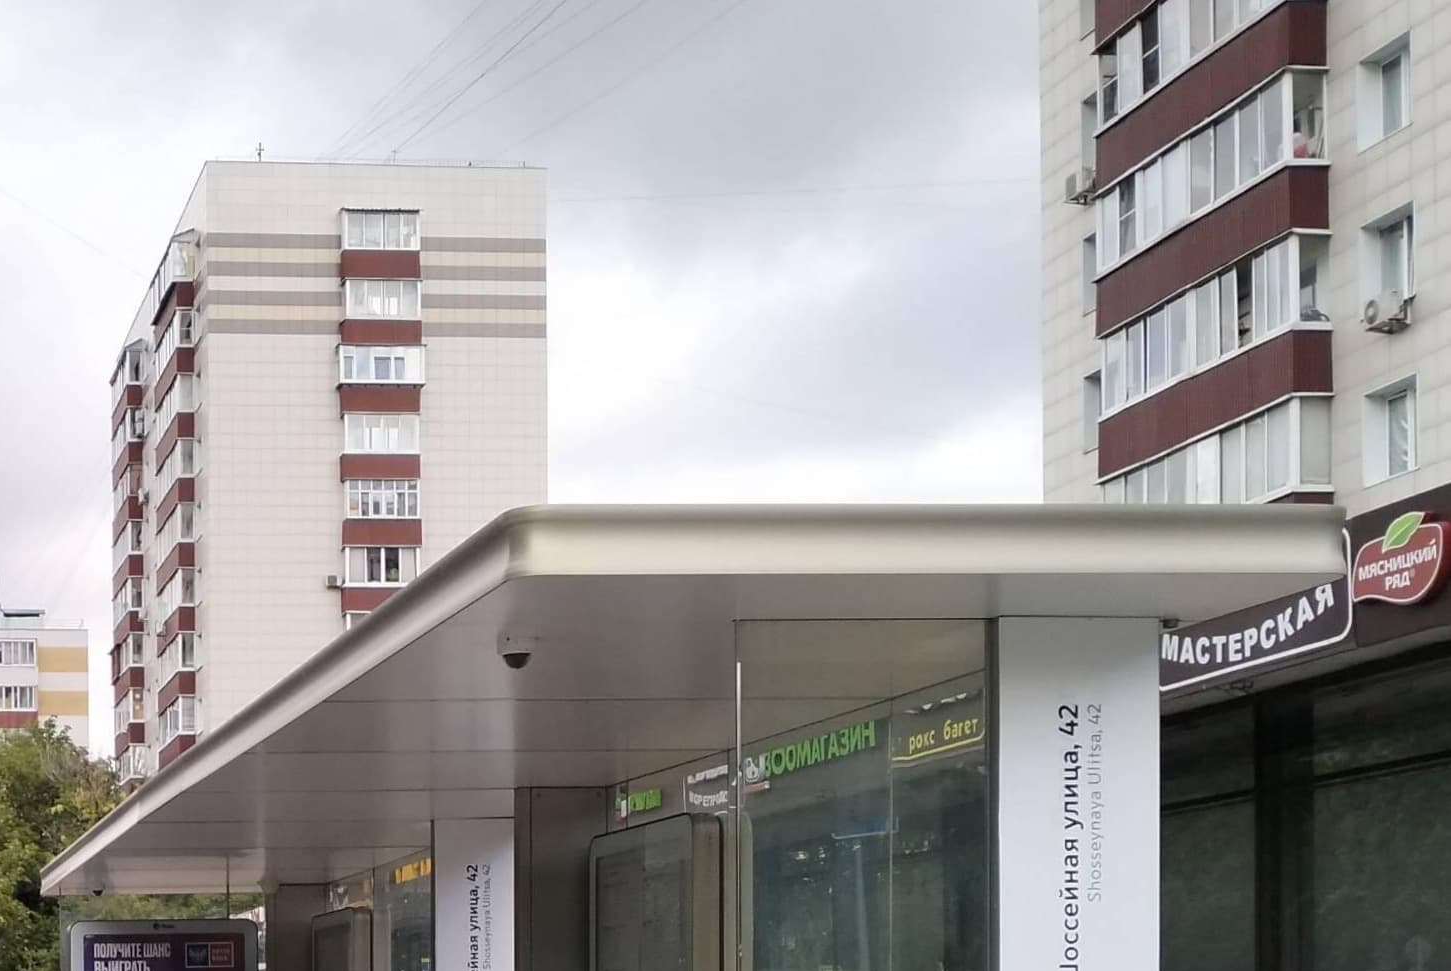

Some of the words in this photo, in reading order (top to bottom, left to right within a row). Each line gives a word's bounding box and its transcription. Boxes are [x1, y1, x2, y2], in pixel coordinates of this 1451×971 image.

[1358, 538, 1438, 582] МЯСНИЦКИЙ
[1384, 572, 1411, 591] РЯД
[1161, 583, 1335, 665] МАСТЕРСКАЯ
[943, 719, 979, 740] багет
[1058, 703, 1079, 737] 42
[1087, 703, 1102, 728] 42
[763, 719, 876, 777] ЗООМАГАЗИН
[1087, 729, 1103, 785] Ulitsa,
[1063, 745, 1084, 830] улица,
[1087, 790, 1104, 902] Shosseynaya
[466, 864, 479, 882] 42
[469, 886, 481, 933] улица,
[93, 943, 142, 958] ПОЛУЧИТЕ
[143, 943, 171, 958] ШАНС
